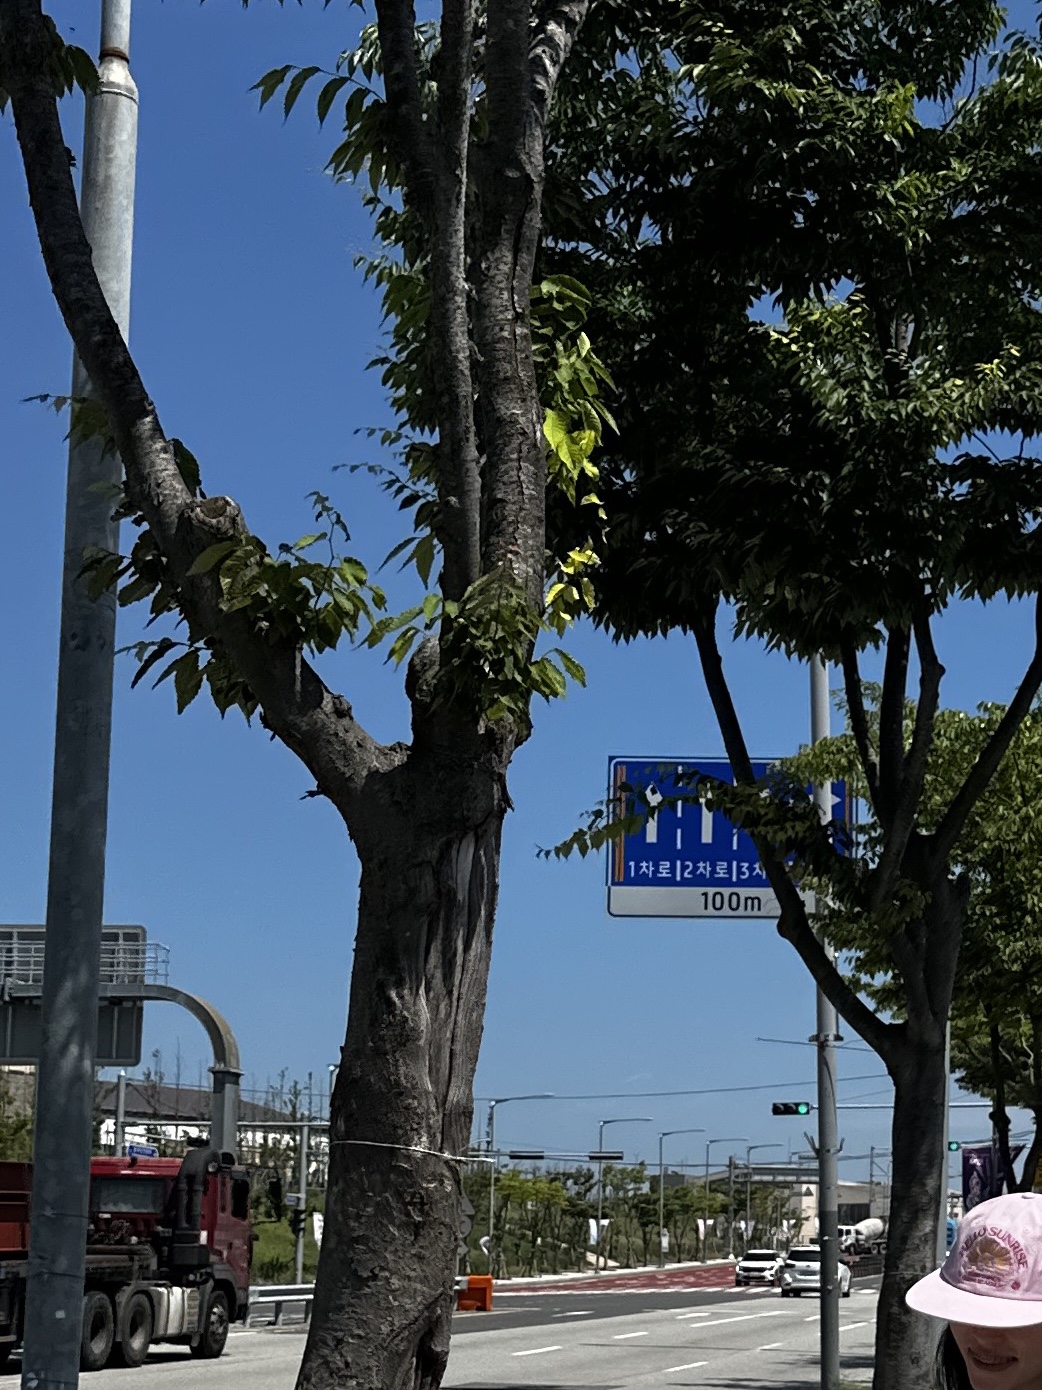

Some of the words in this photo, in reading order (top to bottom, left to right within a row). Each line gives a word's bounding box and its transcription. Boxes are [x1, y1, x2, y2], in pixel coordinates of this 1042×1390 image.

[628, 860, 673, 879] 1차로
[683, 860, 730, 879] 2차로
[739, 861, 768, 880] 3차
[700, 890, 762, 912] 100m
[988, 1226, 1029, 1269] SUNRISE
